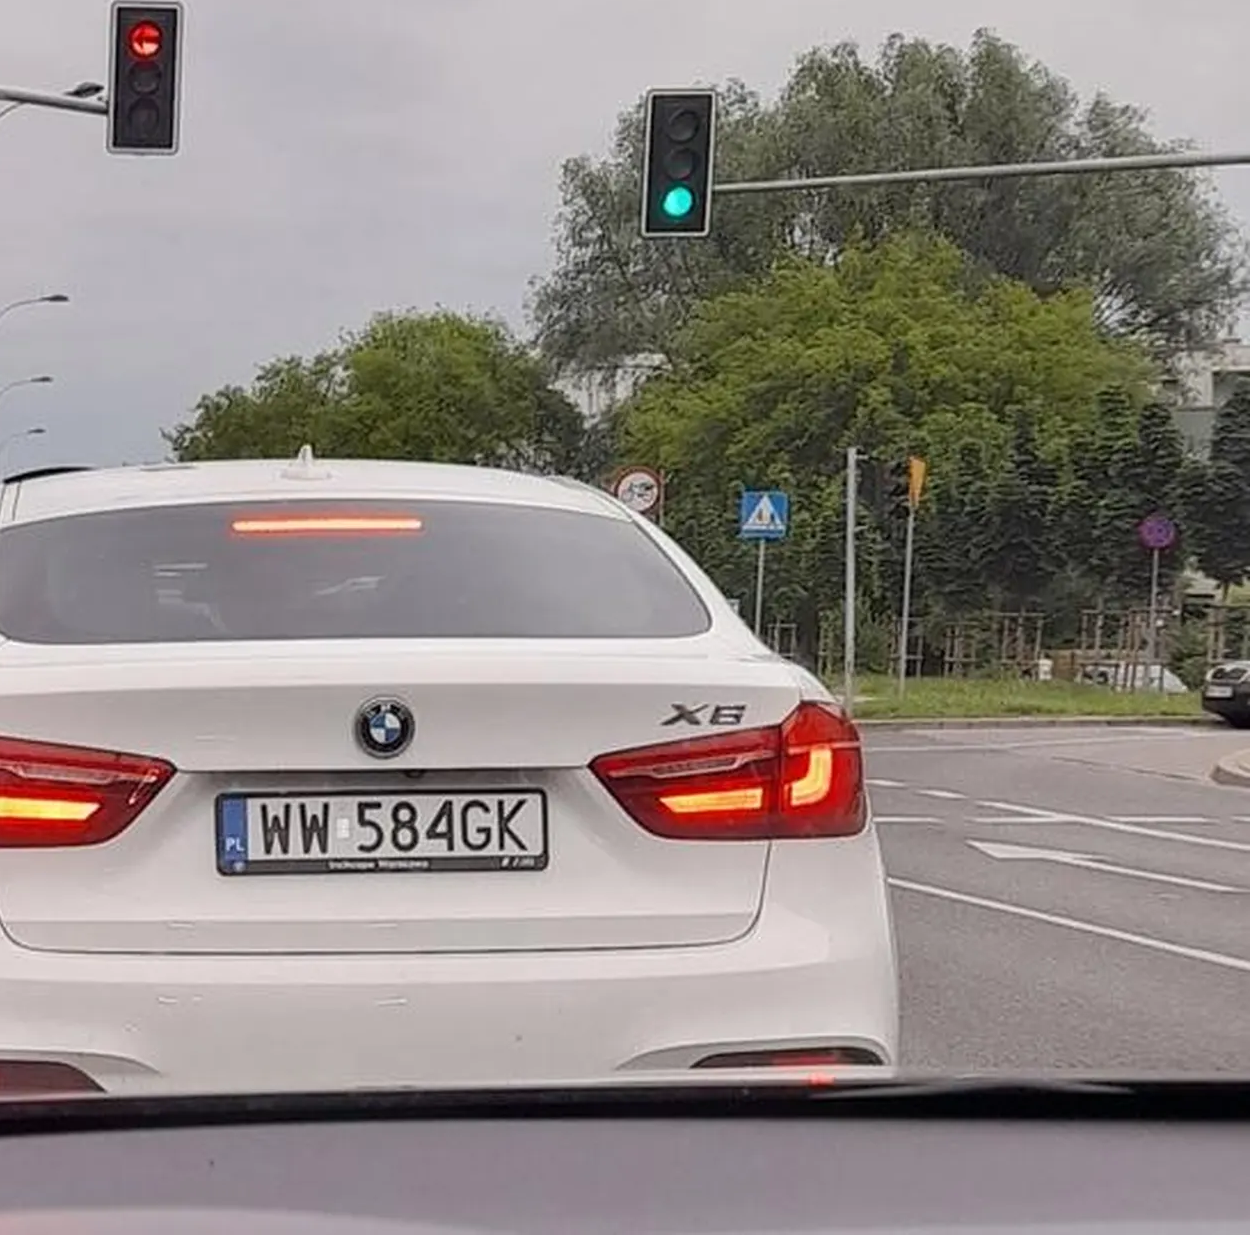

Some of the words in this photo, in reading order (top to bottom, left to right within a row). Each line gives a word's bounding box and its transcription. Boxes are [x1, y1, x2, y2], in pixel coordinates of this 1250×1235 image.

[660, 704, 746, 726] X6
[261, 801, 329, 855] WW
[356, 799, 528, 853] 584GK
[225, 837, 245, 852] PL
